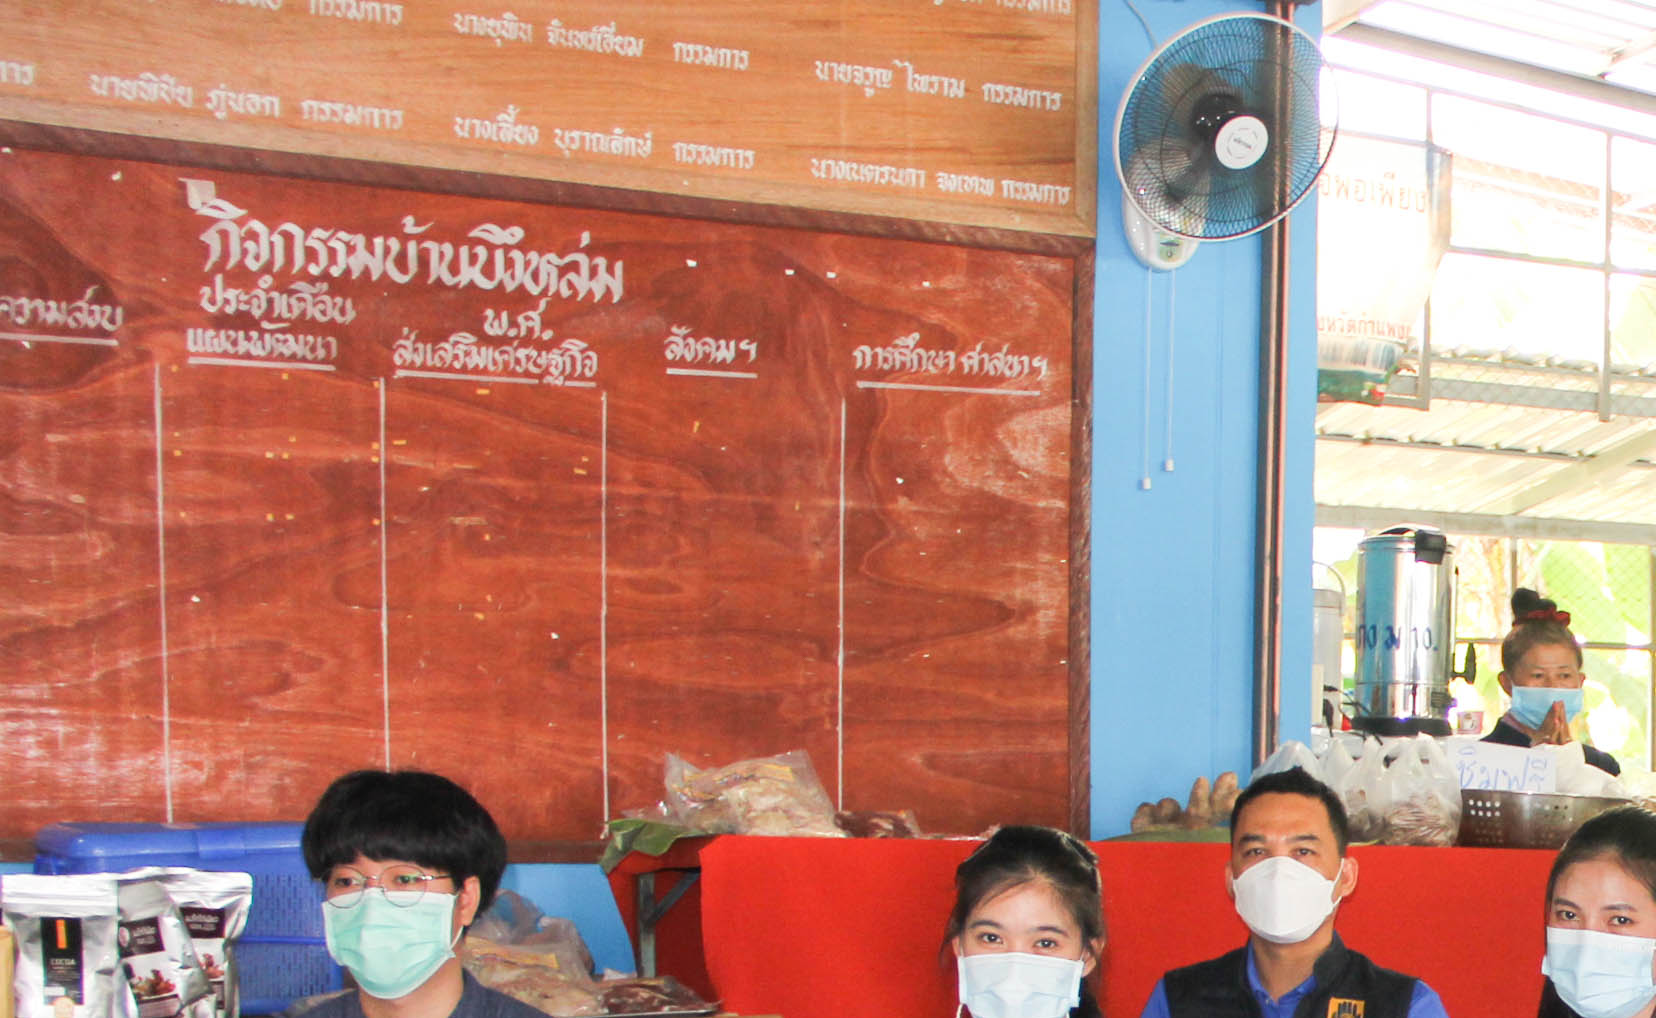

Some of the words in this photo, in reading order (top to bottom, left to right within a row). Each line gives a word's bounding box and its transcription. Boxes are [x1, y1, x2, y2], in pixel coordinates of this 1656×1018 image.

[672, 41, 749, 71] กรรมการ
[982, 82, 1062, 112] กรรมการ
[300, 98, 404, 132] กรรมการ
[671, 141, 756, 170] กรรมการ
[1001, 179, 1072, 206] กรรมการ
[200, 274, 357, 326] ประจำเดือน
[187, 320, 338, 361] แผนพัฒนา
[393, 327, 599, 386] ส่งเสริมเศรษฐกิจ
